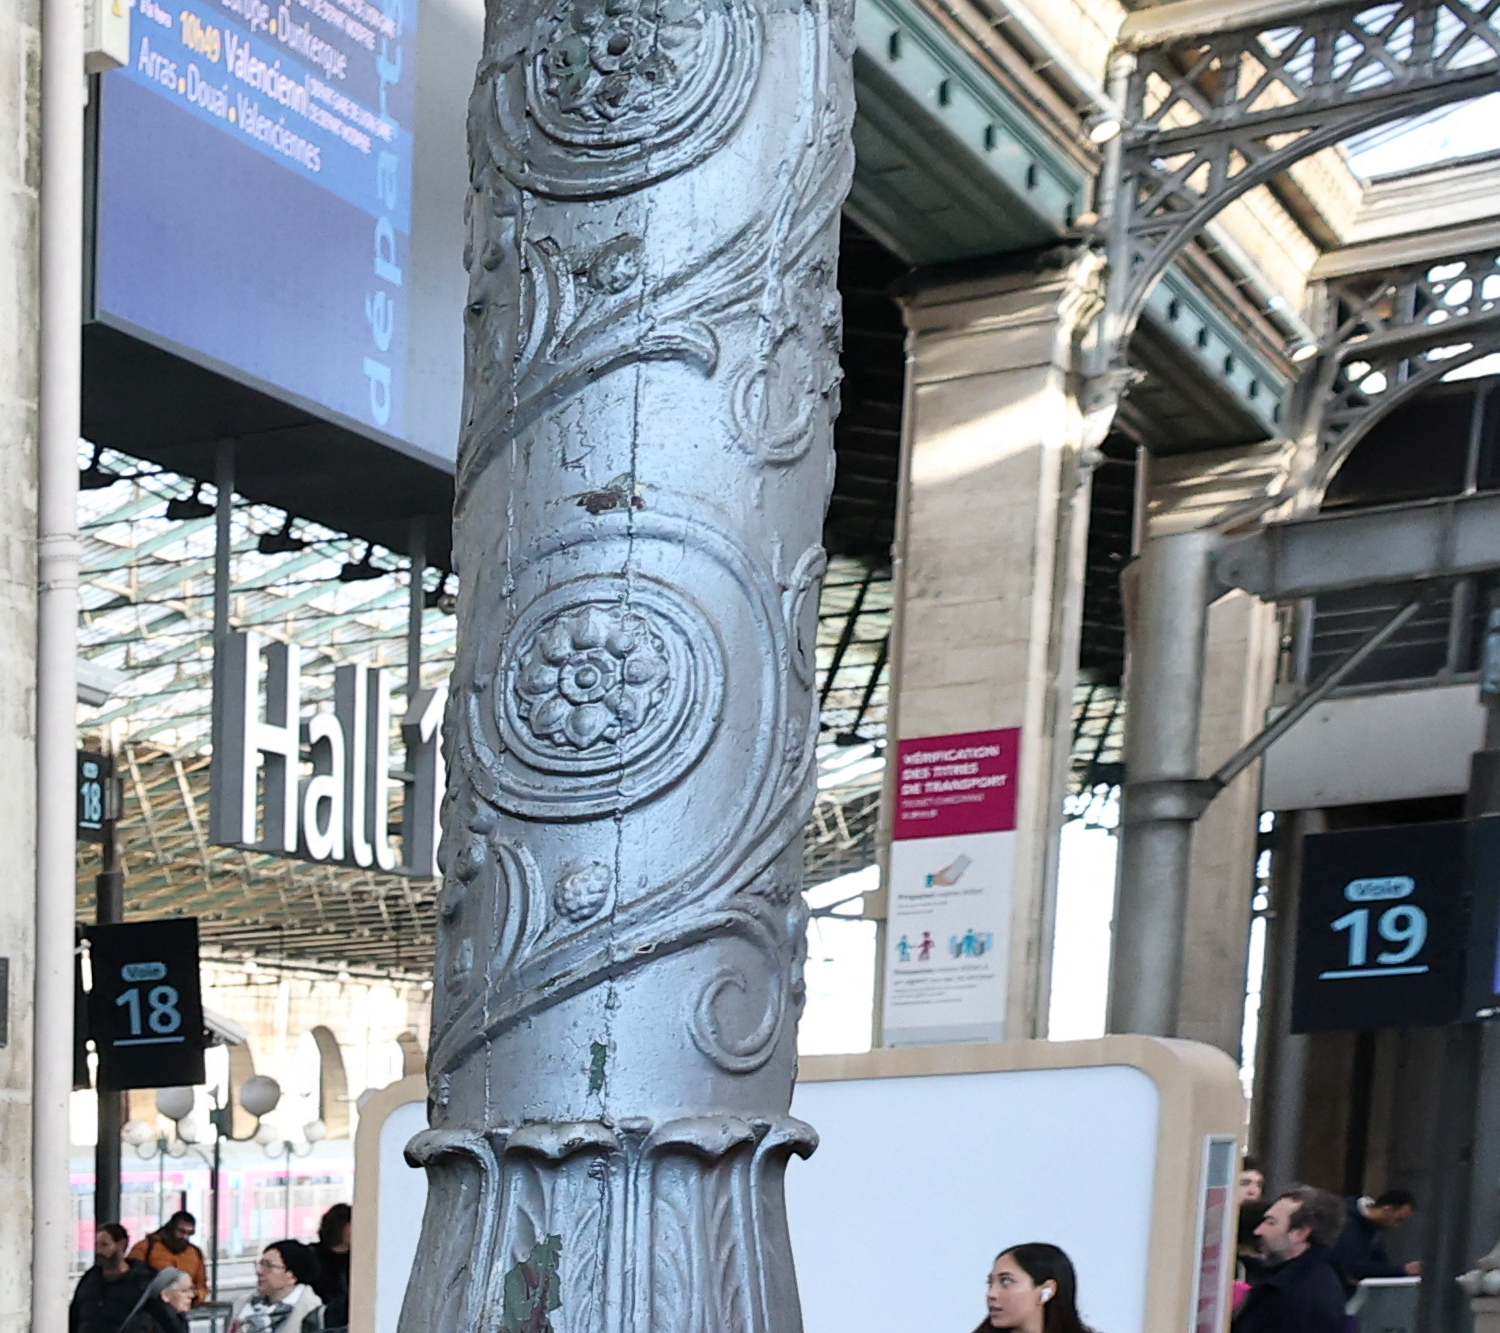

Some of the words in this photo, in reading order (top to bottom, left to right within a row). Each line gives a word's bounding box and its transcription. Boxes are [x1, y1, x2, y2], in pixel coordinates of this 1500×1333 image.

[138, 36, 178, 90] Arras
[187, 62, 228, 119] Douai
[236, 92, 322, 172] Valenciennes
[242, 631, 395, 872] Hall
[79, 781, 102, 822] 18
[1330, 903, 1428, 966] 19
[114, 985, 183, 1036] 18
